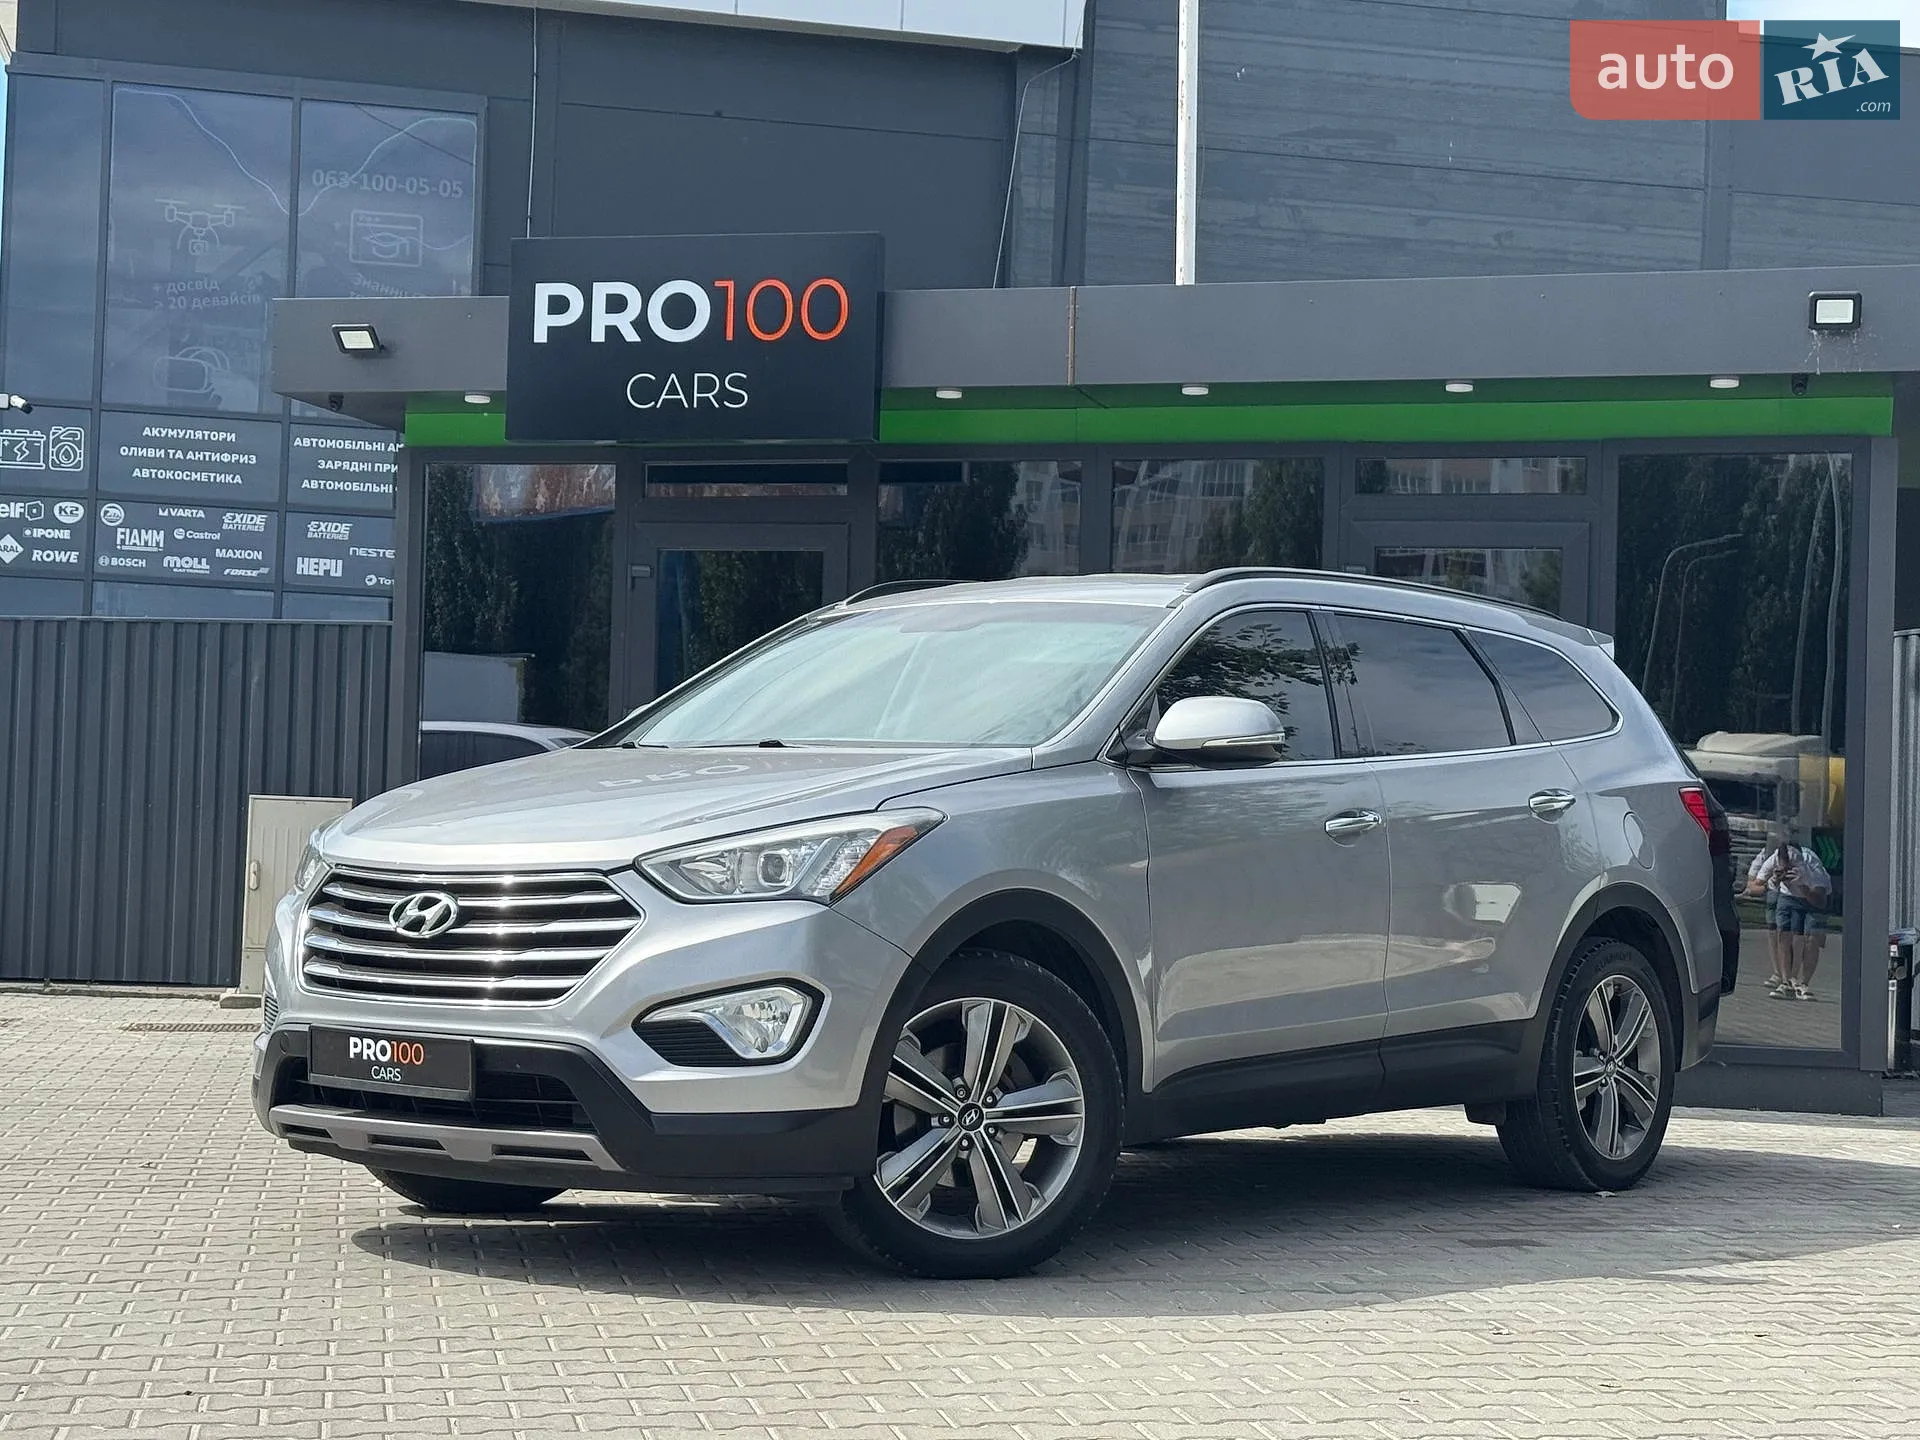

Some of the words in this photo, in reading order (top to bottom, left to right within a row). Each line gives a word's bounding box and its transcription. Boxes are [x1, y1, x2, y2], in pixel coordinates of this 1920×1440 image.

[312, 169, 464, 198] 063-100-05-05
[168, 296, 186, 309] 20
[532, 277, 850, 344] PRO100
[626, 372, 749, 410] CARS
[142, 426, 236, 442] АКУМУЛЯТОРИ
[294, 437, 384, 452] АВТОМОБІЛЬНІ
[120, 446, 164, 458] ОЛИВИ
[168, 448, 184, 460] ТА
[186, 450, 256, 464] АНТИФРИЗ
[318, 460, 372, 472] ЗАРЯДНІ
[374, 462, 398, 473] ПРИ
[132, 467, 242, 484] АВТОКОСМЕТИКА
[302, 479, 392, 494] АВТОМОБІЛЬНІ
[58, 505, 79, 515] K2
[170, 507, 206, 518] VARTA
[222, 512, 268, 526] EXIDE
[32, 528, 71, 540] IPONE
[308, 521, 352, 533] EXIDE
[116, 528, 164, 548] FIAMM
[186, 532, 220, 541] Castrol
[32, 550, 80, 563] ROWE
[216, 548, 262, 560] MAXION
[110, 557, 146, 568] BOSCH
[163, 556, 210, 569] MOLL
[296, 556, 344, 577] HEPU
[348, 1035, 425, 1067] PRO100
[371, 1065, 402, 1082] CARS
